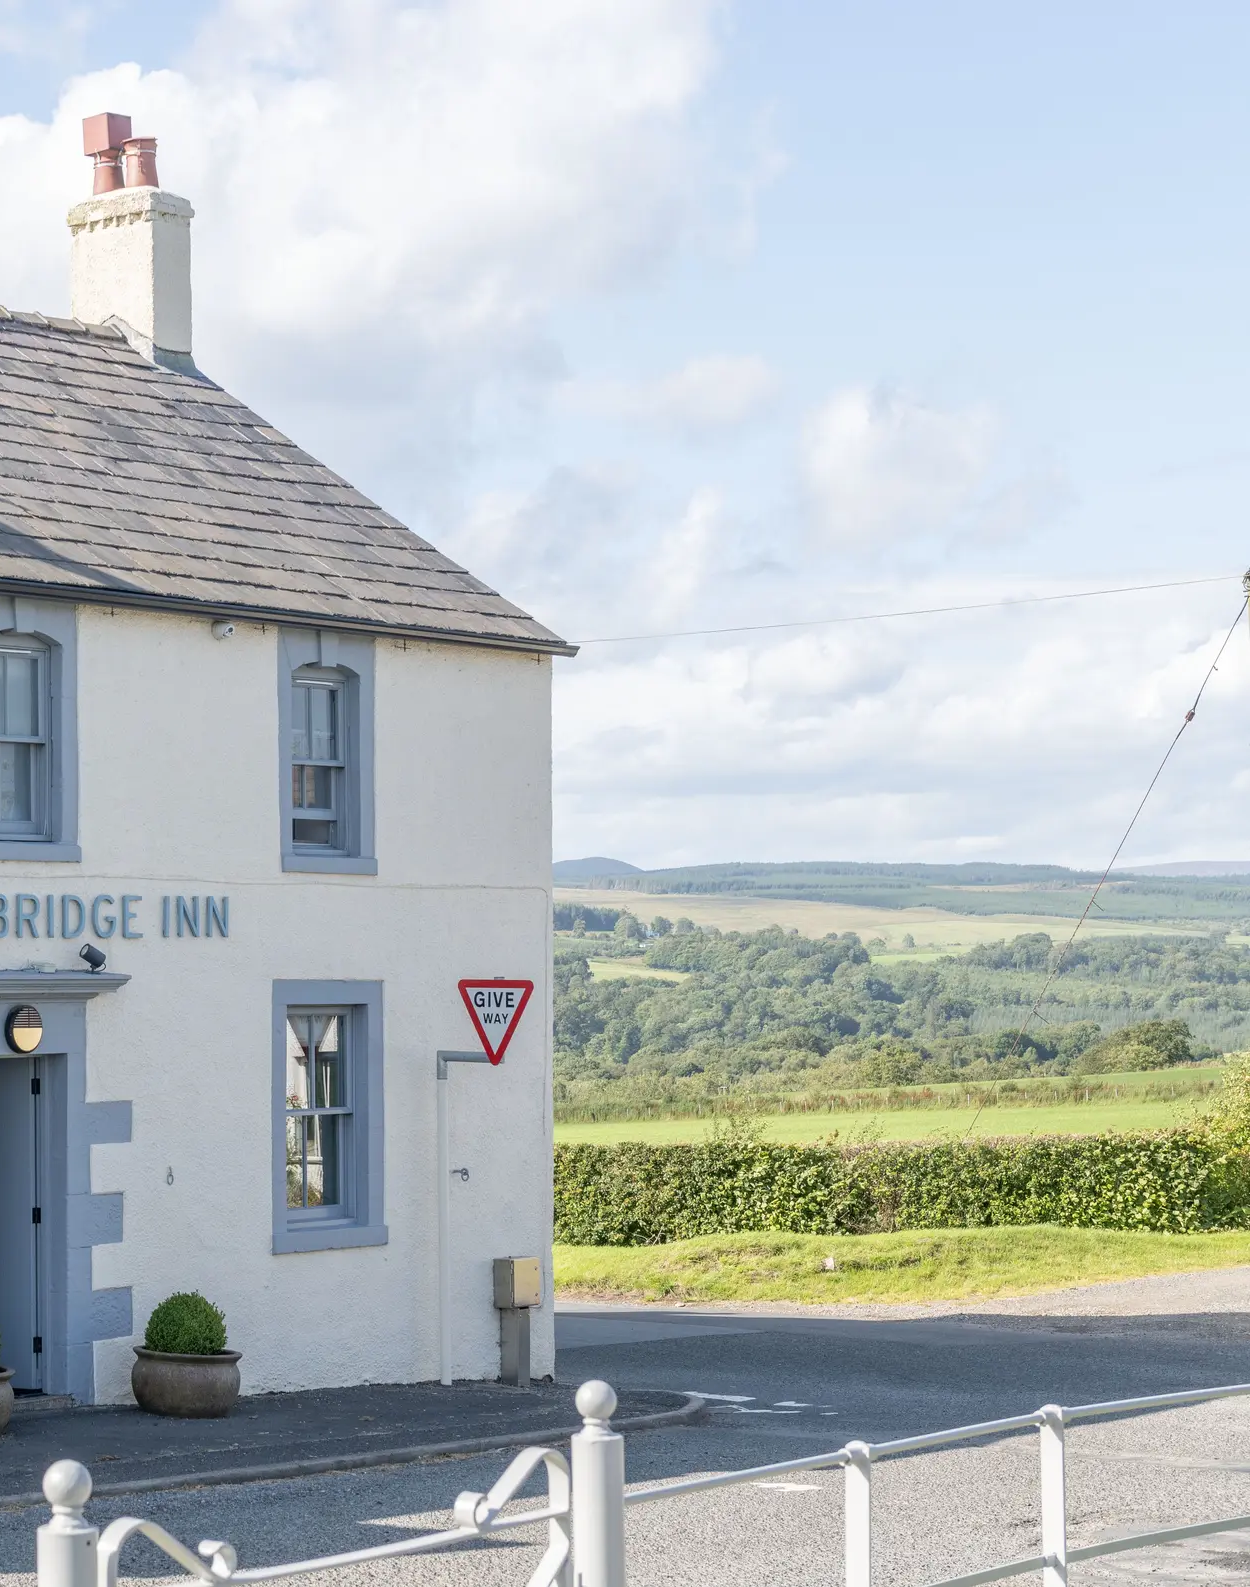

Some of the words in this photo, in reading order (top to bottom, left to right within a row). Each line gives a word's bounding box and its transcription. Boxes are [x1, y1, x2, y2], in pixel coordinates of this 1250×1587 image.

[162, 895, 230, 938] INN
[473, 991, 515, 1008] GIVE
[482, 1012, 509, 1024] WAY
